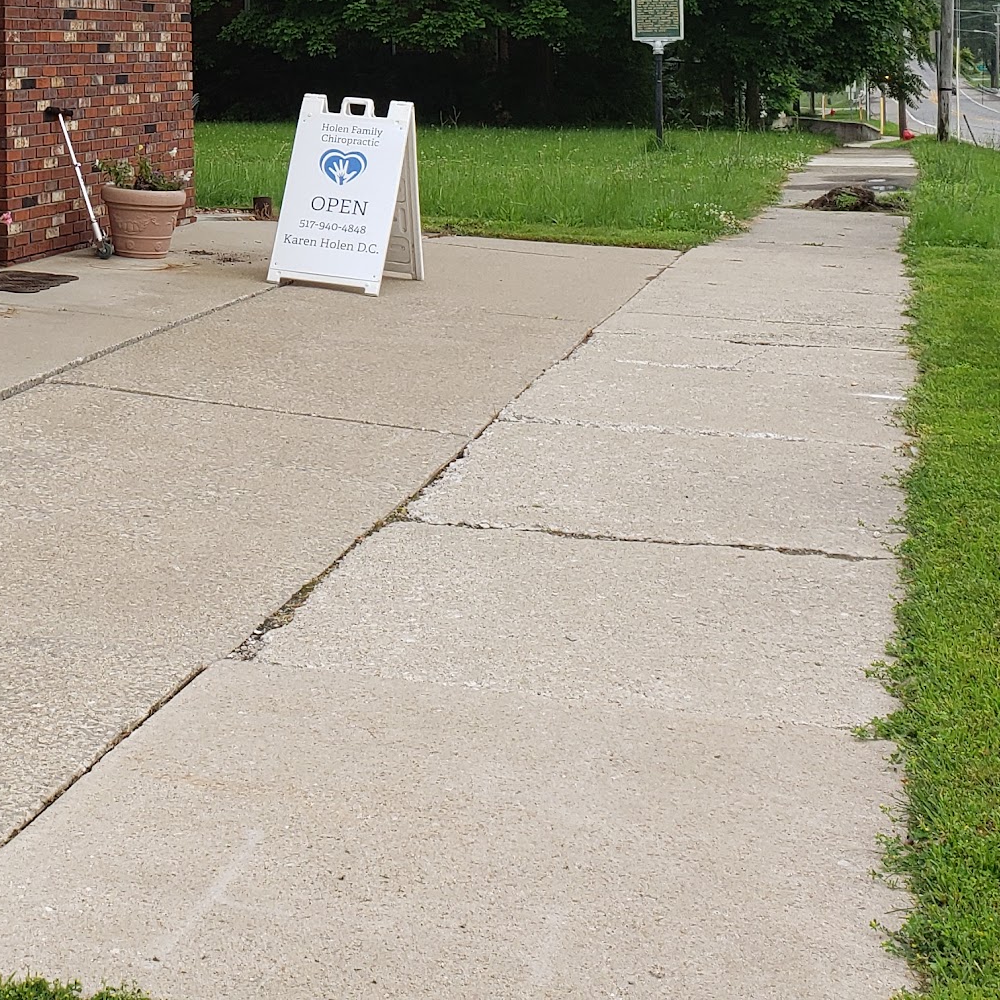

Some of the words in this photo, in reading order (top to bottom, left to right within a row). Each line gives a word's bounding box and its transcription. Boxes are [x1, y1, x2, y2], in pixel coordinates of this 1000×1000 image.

[321, 123, 349, 134] Holen
[351, 126, 383, 138] Family
[321, 134, 380, 147] Chiropractic
[311, 196, 369, 216] OPEN
[299, 219, 367, 234] 517-940-4848
[283, 233, 317, 247] Karen
[320, 238, 354, 252] Holen
[357, 242, 379, 254] D.C.
